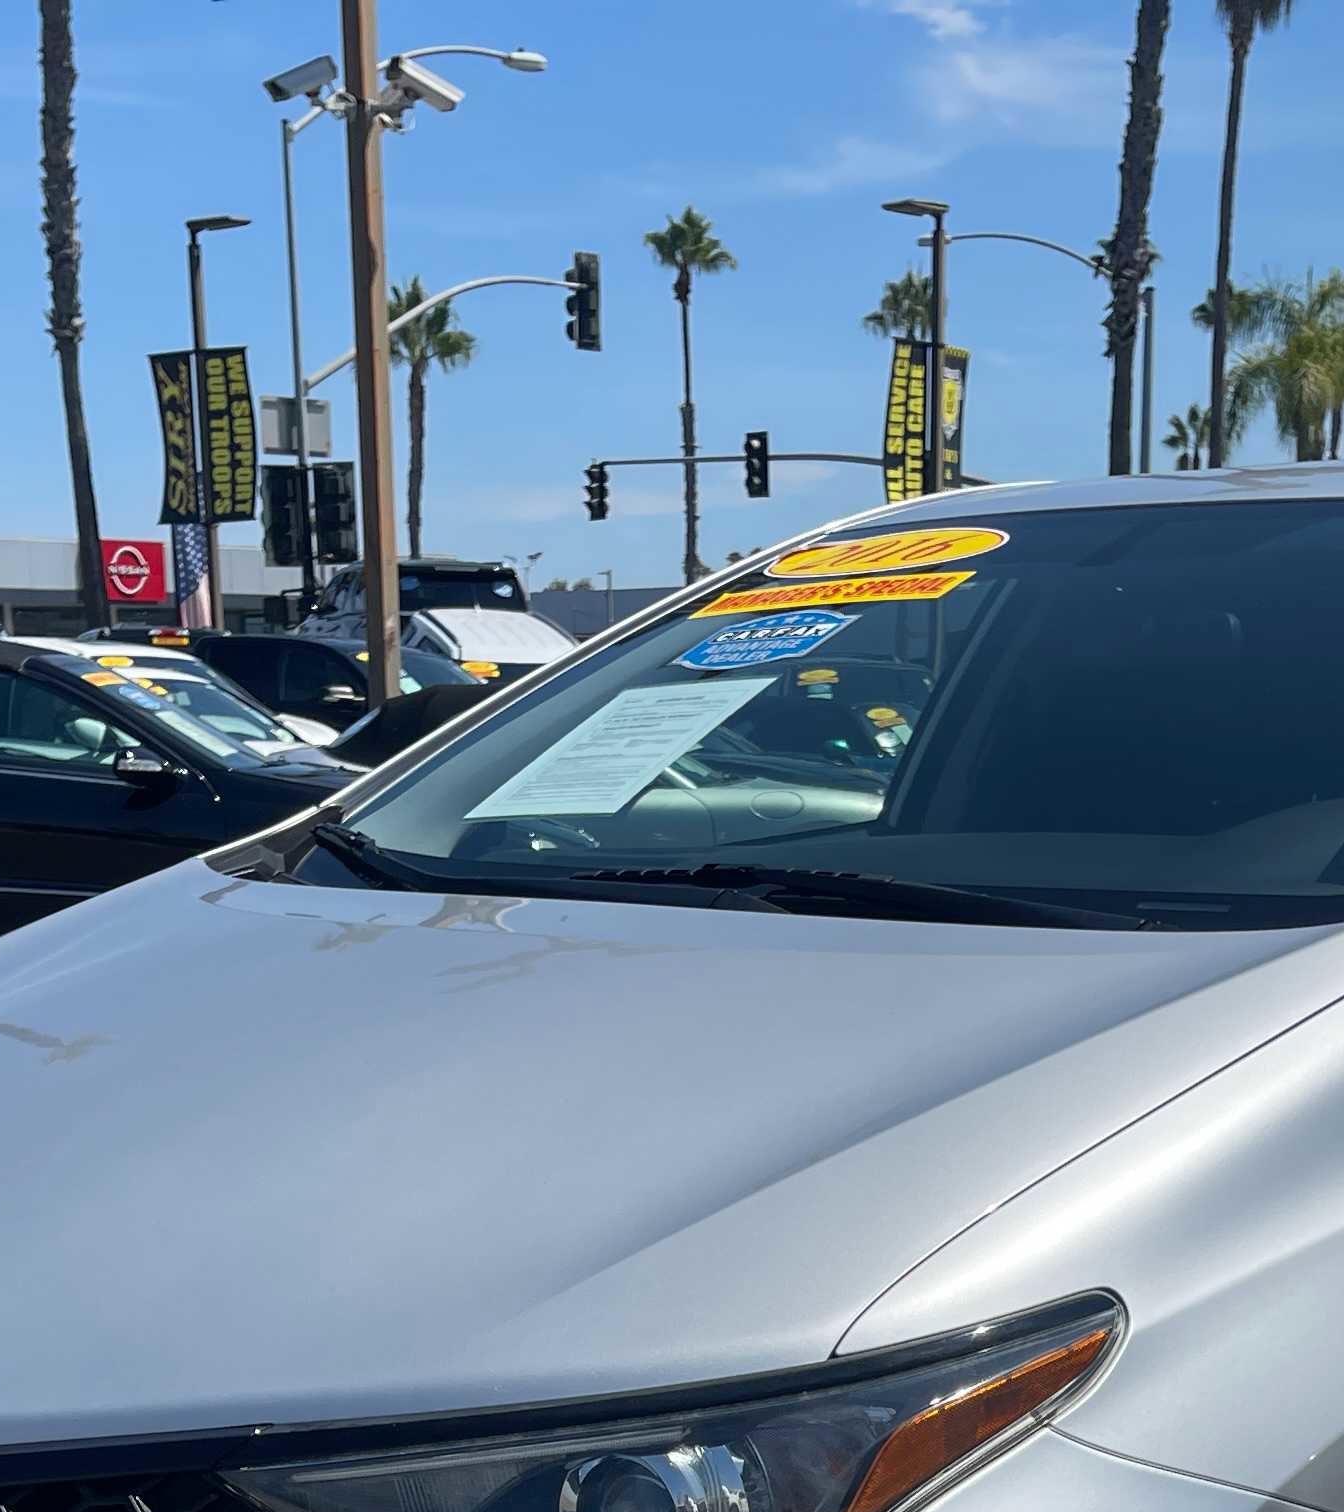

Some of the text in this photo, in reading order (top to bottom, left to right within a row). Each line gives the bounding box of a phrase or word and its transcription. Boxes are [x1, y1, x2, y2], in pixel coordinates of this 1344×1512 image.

[886, 344, 912, 504] ULL SERVICE
[906, 365, 925, 432] CARE
[207, 358, 232, 515] OUR TROOPS
[226, 354, 254, 515] WE SUPPORT
[852, 575, 958, 598] SPECIAL
[702, 649, 772, 664] DEALER
[703, 637, 802, 655] ADVANTAGE
